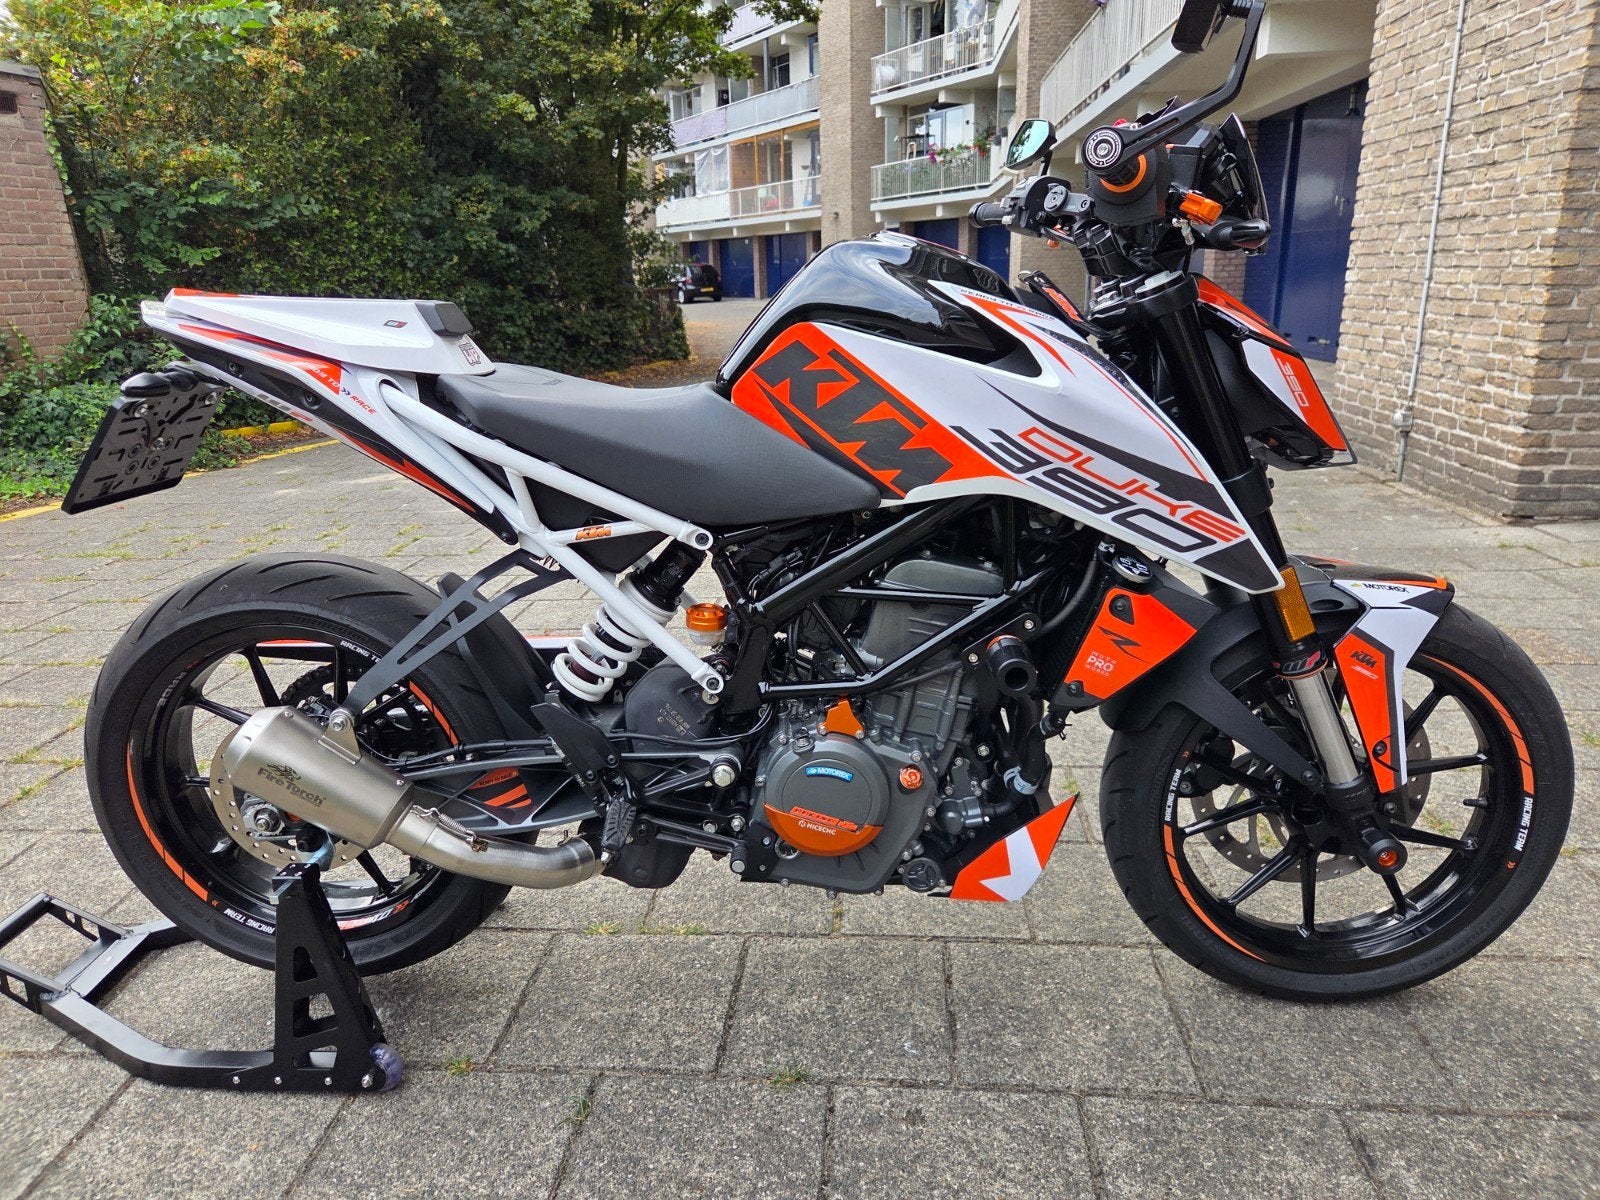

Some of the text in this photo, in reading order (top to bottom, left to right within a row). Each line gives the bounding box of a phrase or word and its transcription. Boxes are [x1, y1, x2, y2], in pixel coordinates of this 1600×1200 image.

[1277, 358, 1309, 407] 390
[350, 395, 377, 415] RACE
[753, 340, 954, 497] KTM
[951, 425, 1217, 554] 390
[1018, 426, 1246, 543] DUKE
[575, 525, 612, 540] KTM
[1363, 582, 1409, 594] MOTOREX
[340, 640, 371, 658] RACING
[1091, 650, 1118, 665] MOTO
[1086, 655, 1114, 672] PRO
[1350, 650, 1377, 669] KTM
[1085, 663, 1110, 677] WORKS
[818, 767, 851, 780] MOTOREX
[257, 767, 285, 787] Fire
[285, 780, 324, 807] Torch
[1164, 792, 1175, 822] RACING
[1520, 796, 1534, 828] RACING
[806, 823, 837, 836] NICECNC
[247, 918, 275, 934] RACING
